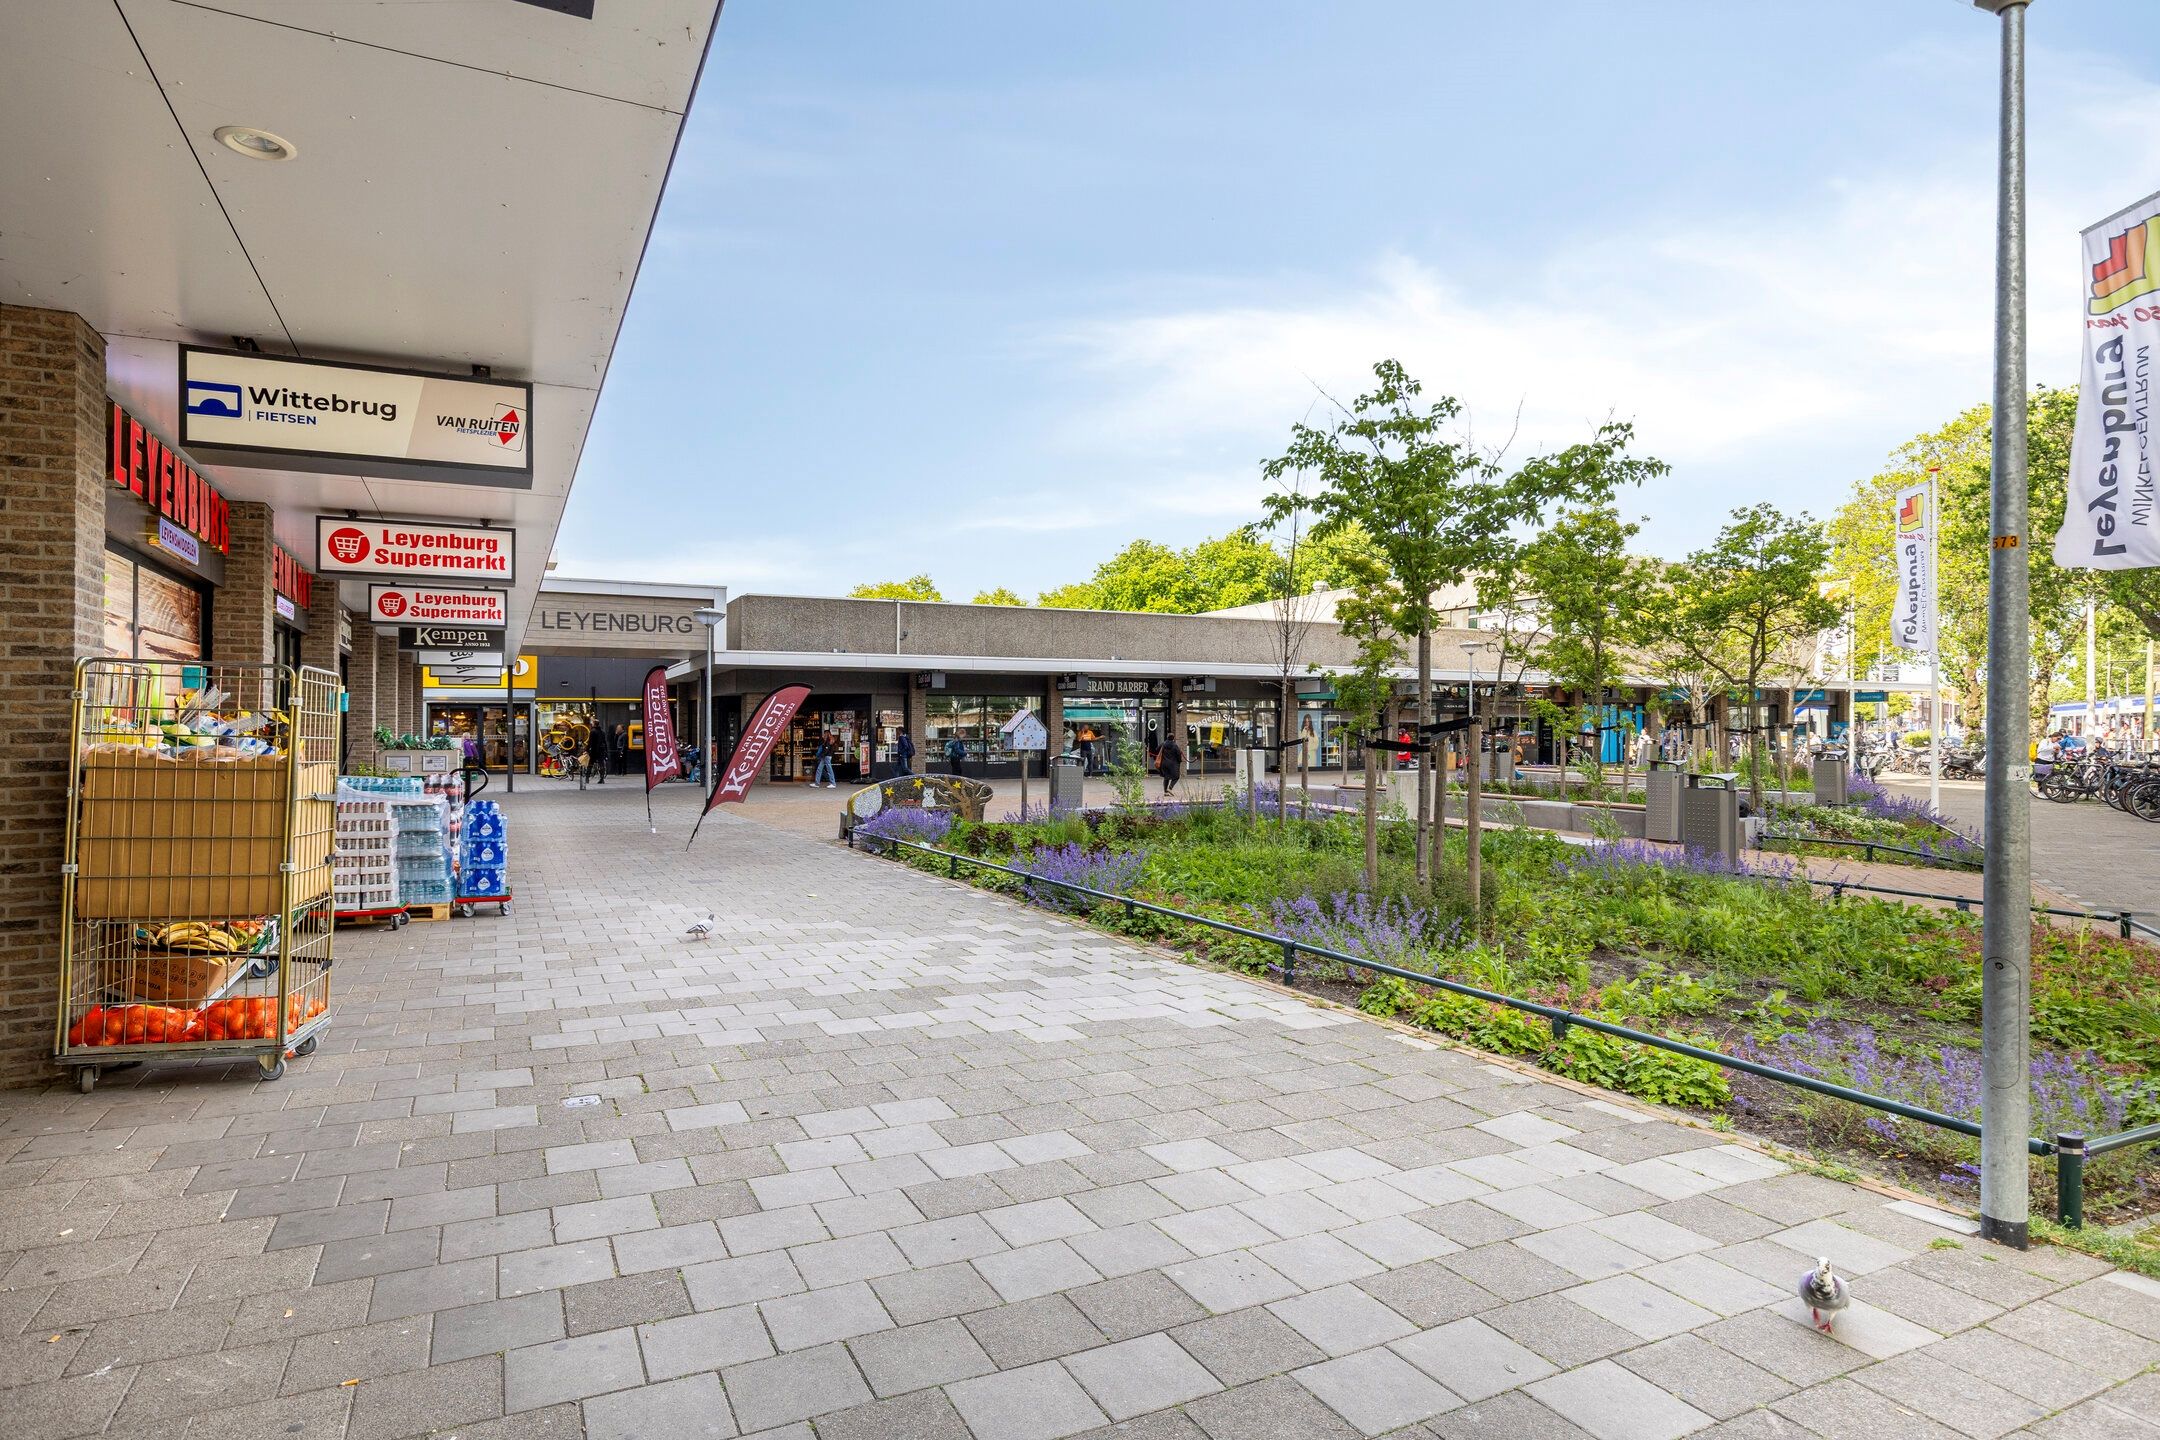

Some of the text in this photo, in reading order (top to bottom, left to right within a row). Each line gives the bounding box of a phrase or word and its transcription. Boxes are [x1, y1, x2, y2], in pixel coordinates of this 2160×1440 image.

[248, 386, 397, 422] Wittebrug
[256, 411, 317, 425] FIETSEN
[436, 415, 466, 427] VAN
[456, 428, 497, 437] FIETSPLEZIER
[113, 402, 230, 557] LEYENBURG
[382, 529, 498, 553] Leyenburg
[1992, 535, 2017, 549] 573
[374, 548, 506, 571] Supermarkt
[415, 592, 497, 607] Leyenburg
[409, 605, 502, 620] Supermarkt
[541, 610, 693, 633] LEYENBURG
[413, 627, 488, 646] Kempen
[1087, 680, 1115, 692] GRAND
[1117, 681, 1149, 693] BARBER
[651, 687, 678, 776] Kempen
[1222, 713, 1249, 734] Simon
[720, 702, 788, 796] Kempen
[740, 735, 754, 753] van
